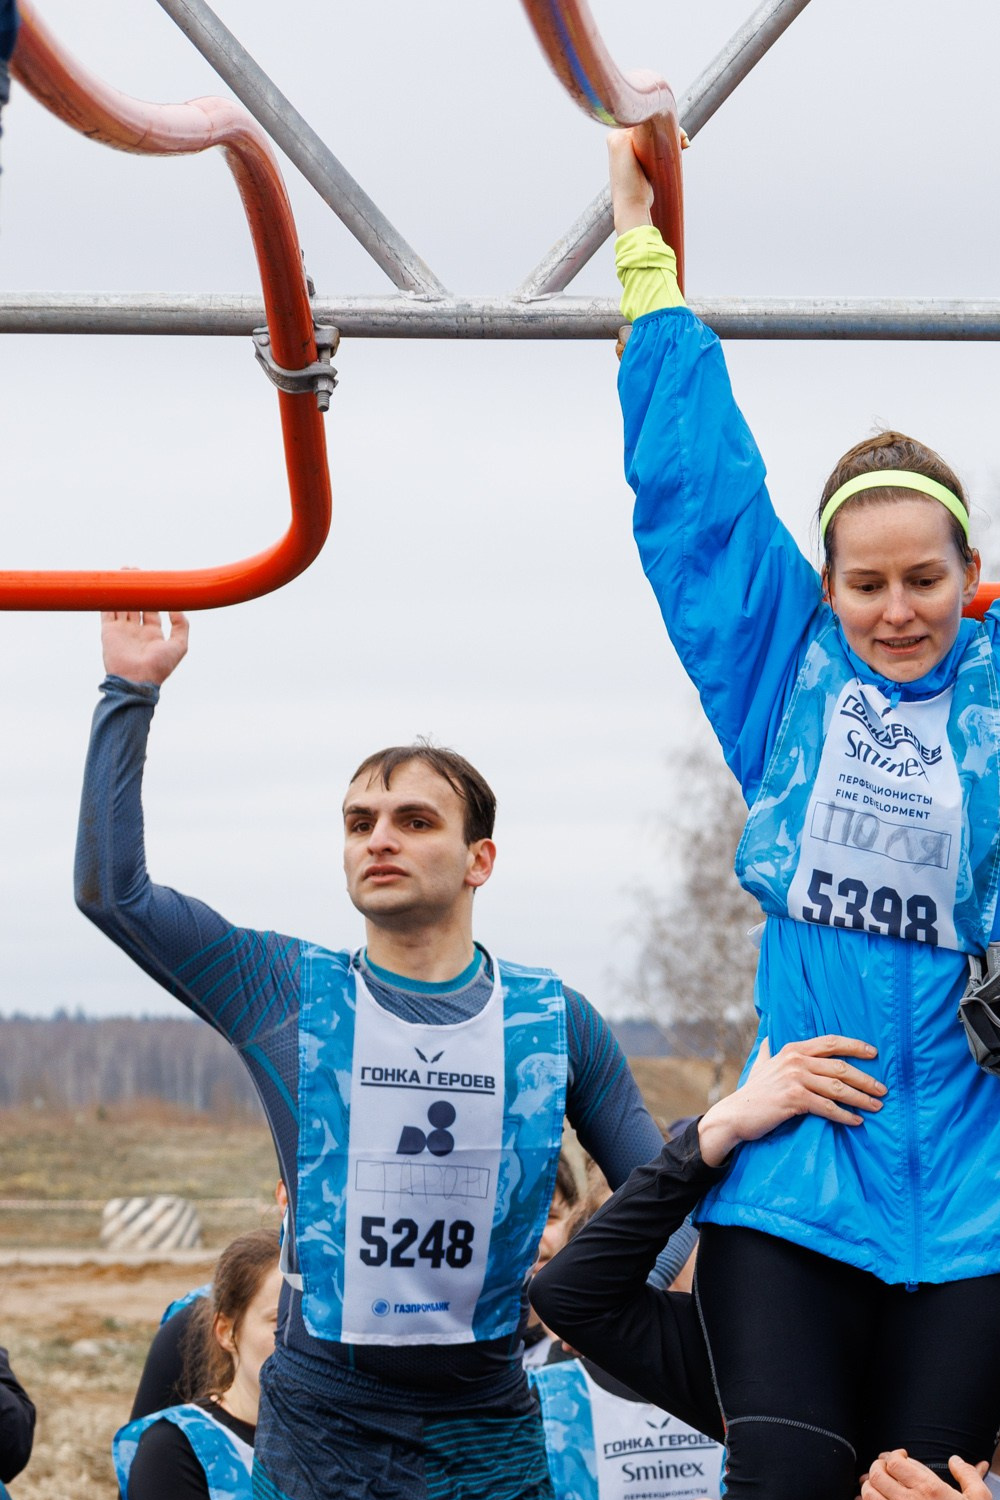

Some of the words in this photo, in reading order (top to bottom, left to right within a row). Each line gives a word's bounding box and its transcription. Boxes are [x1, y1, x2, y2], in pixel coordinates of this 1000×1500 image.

[838, 774, 933, 805] ПЕРФЕКЦИОНИСТЫ
[835, 788, 859, 801] FINE
[862, 795, 931, 820] DEVELOPMENT
[802, 868, 939, 946] 5398
[361, 1066, 421, 1084] ГОНКА
[427, 1070, 496, 1089] ГЕРОЕВ
[360, 1216, 475, 1269] 5248
[394, 1302, 450, 1314] ГАЗПРОМБАНК
[603, 1437, 654, 1454] ГОНКА
[622, 1460, 704, 1483] Sminex
[624, 1488, 708, 1500] ПЕРФЕКЦИОНИСТЫ
